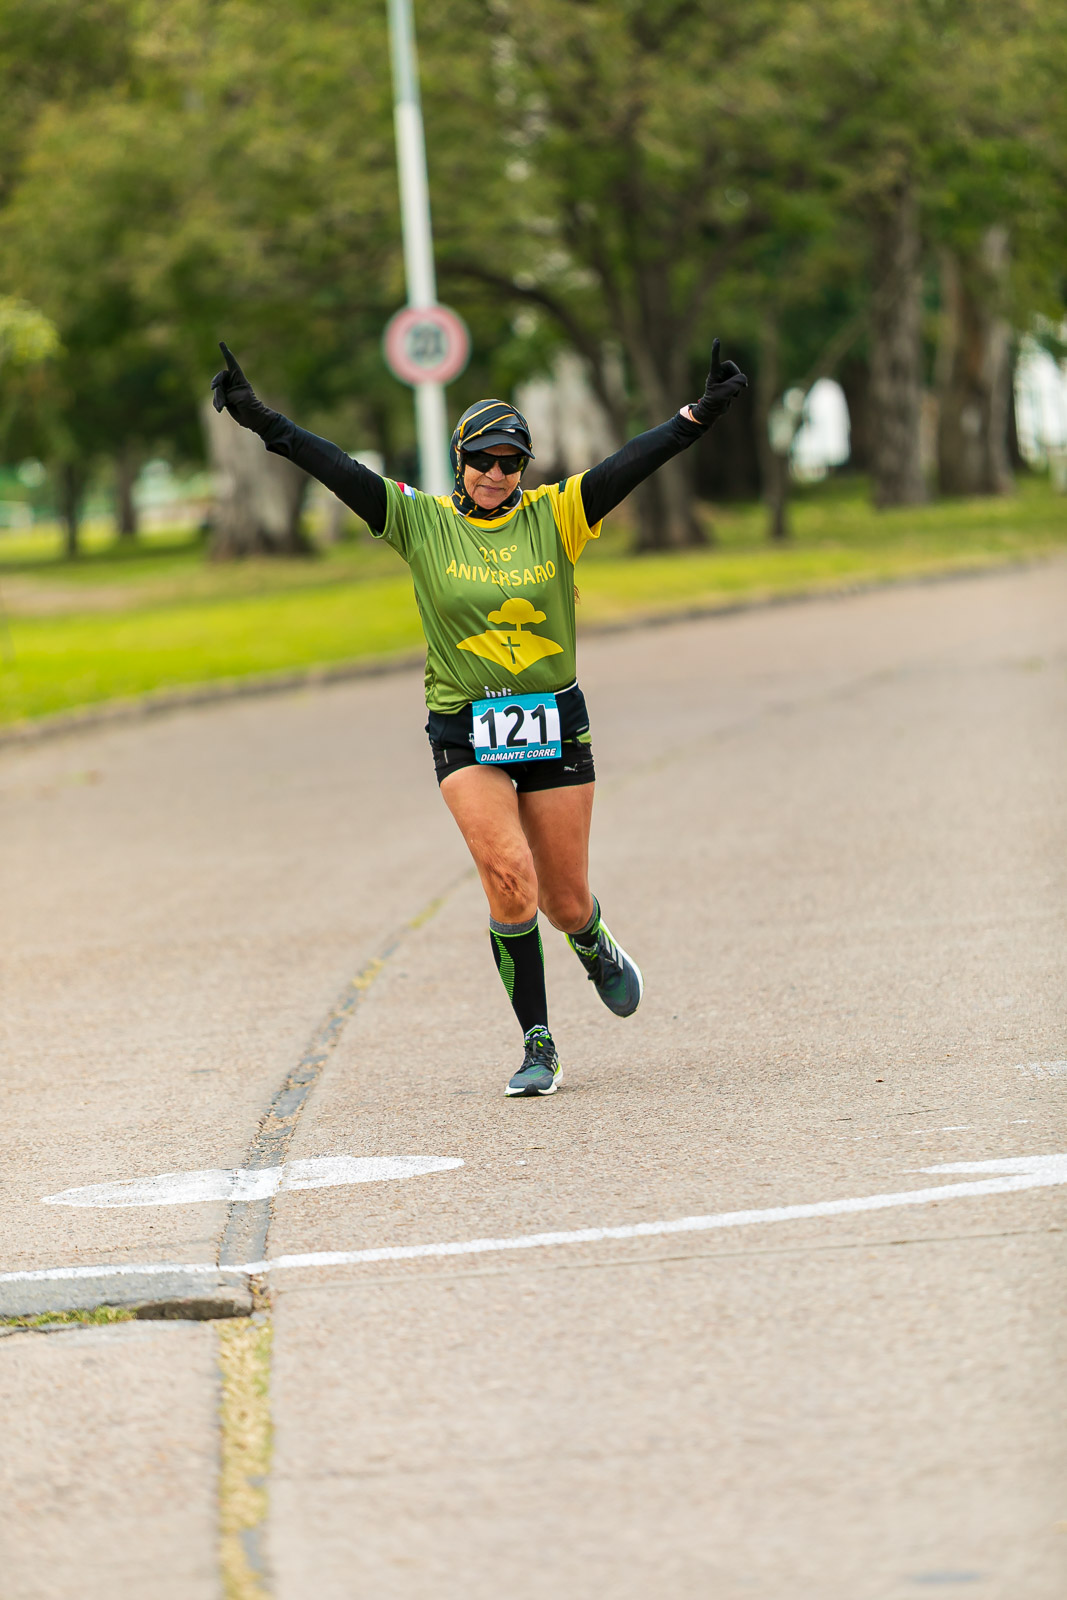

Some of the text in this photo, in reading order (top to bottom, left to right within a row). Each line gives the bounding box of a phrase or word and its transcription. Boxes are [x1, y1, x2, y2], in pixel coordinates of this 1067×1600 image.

[480, 704, 548, 750] 121
[481, 748, 556, 761] DIAMANTE CORRE
